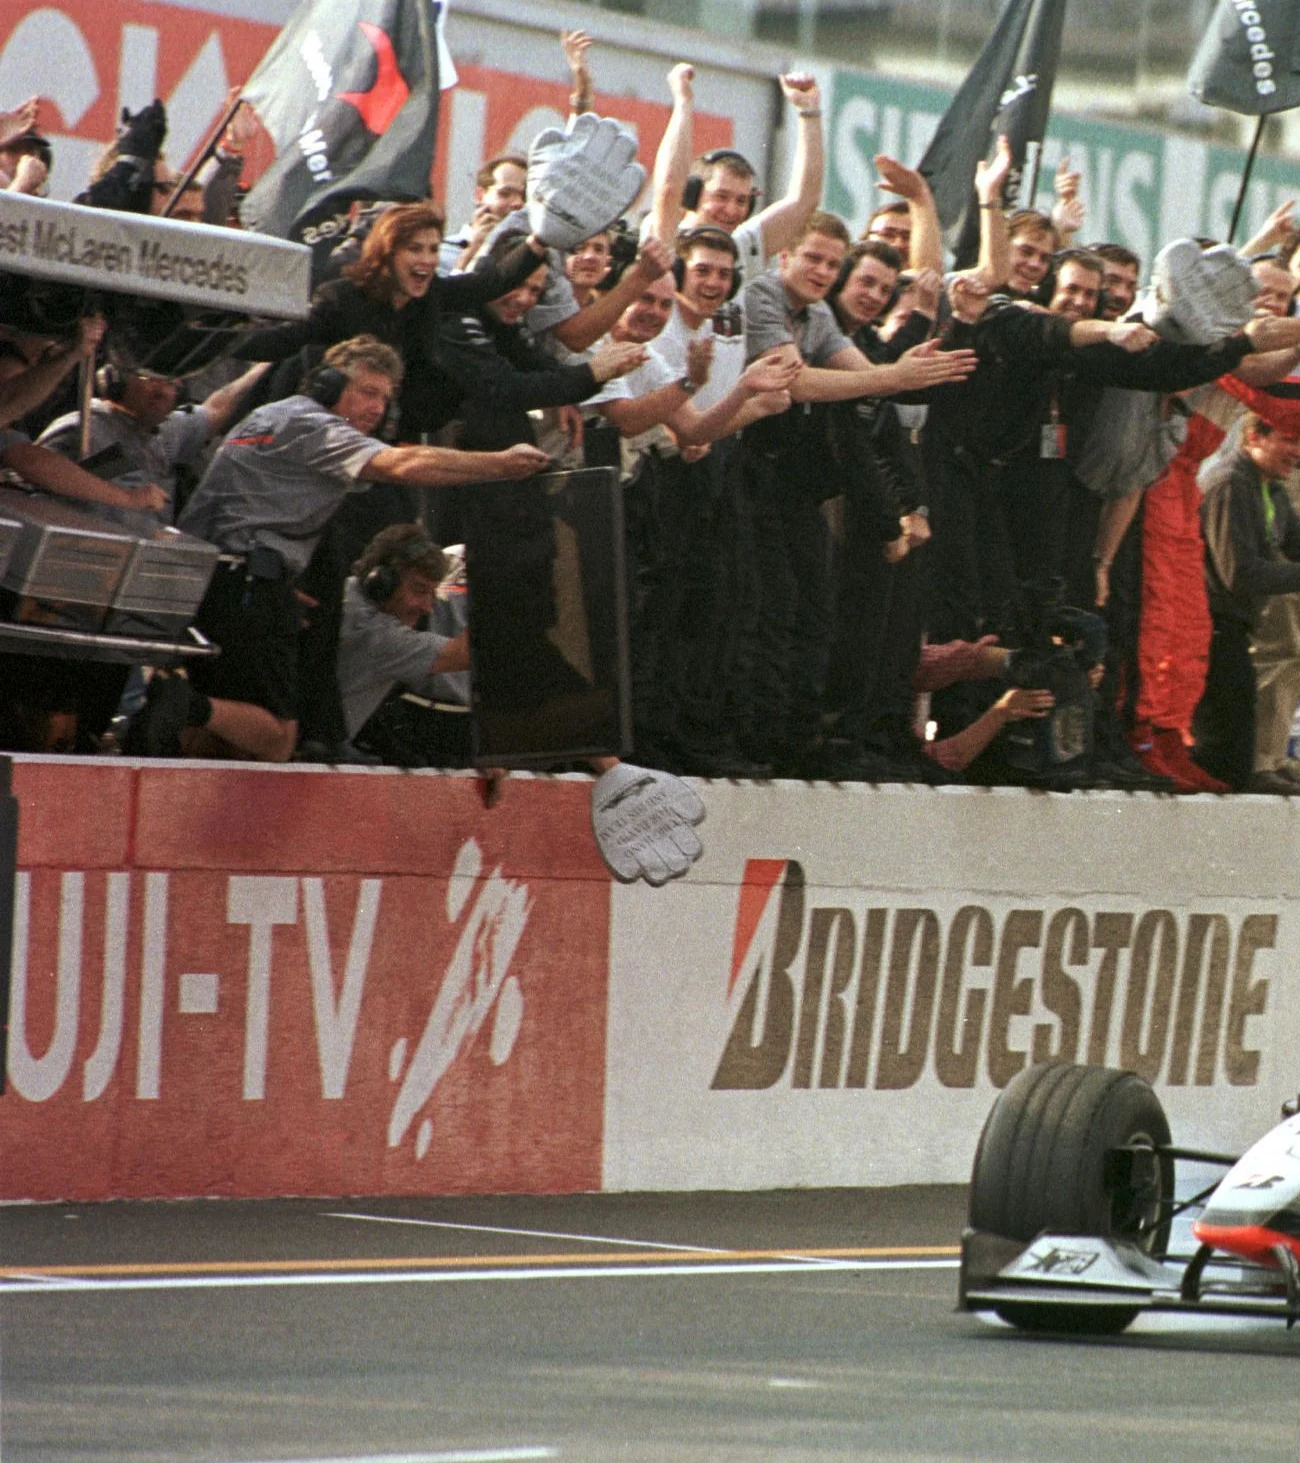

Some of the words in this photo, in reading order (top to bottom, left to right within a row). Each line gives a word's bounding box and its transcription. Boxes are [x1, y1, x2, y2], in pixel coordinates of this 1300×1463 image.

[33, 220, 132, 275] McLaren
[138, 239, 249, 295] Mercedes
[709, 858, 1281, 1090] BRIDGESTONE
